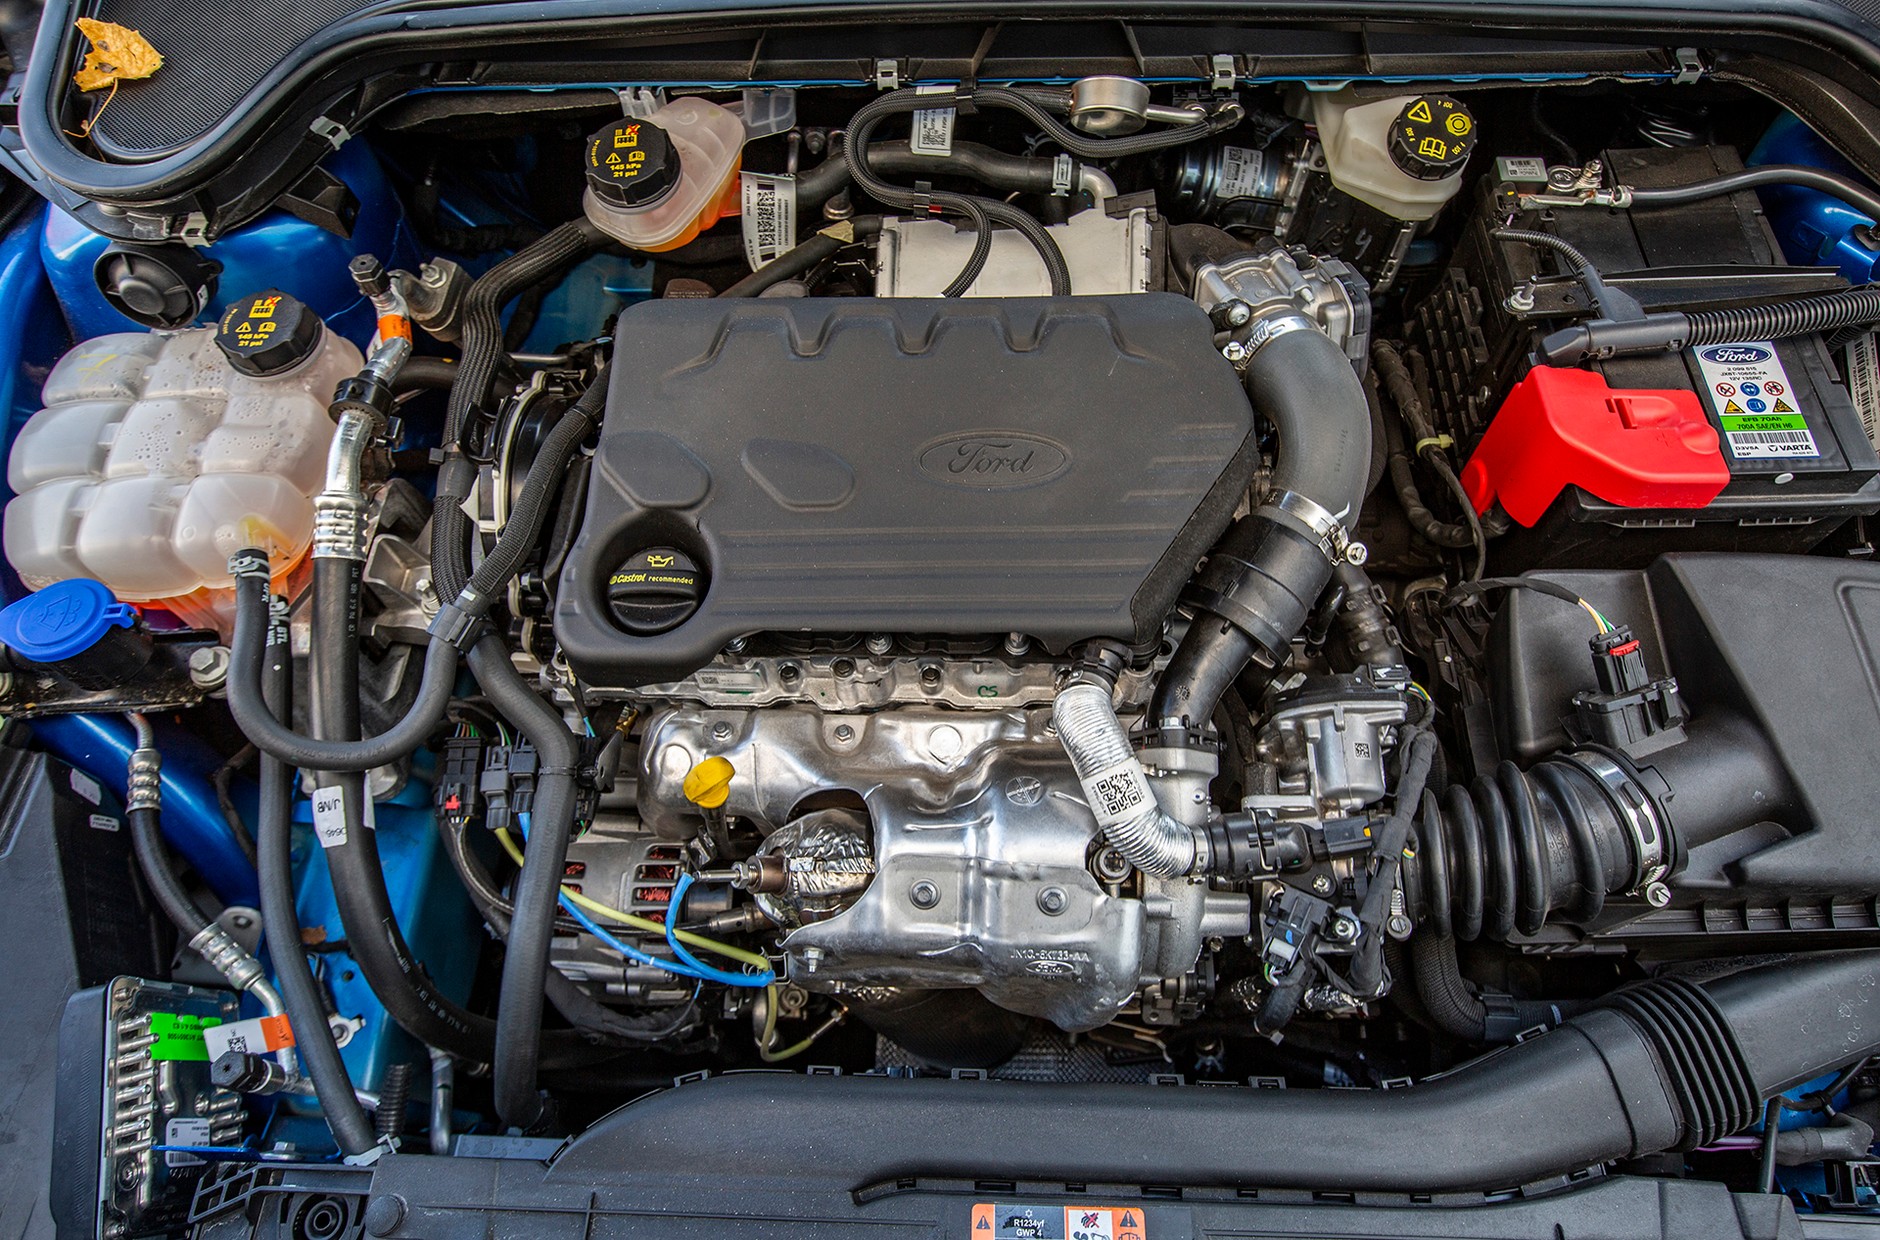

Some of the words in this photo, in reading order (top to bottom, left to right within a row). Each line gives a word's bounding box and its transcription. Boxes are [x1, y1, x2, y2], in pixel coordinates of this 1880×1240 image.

[1716, 348, 1757, 361] Ford
[948, 442, 1034, 474] Ford
[617, 573, 647, 583] Castrol
[648, 576, 693, 584] recommended
[1014, 1219, 1045, 1229] R1234yf
[1016, 1229, 1036, 1237] GWP
[1037, 1229, 1042, 1237] 4
